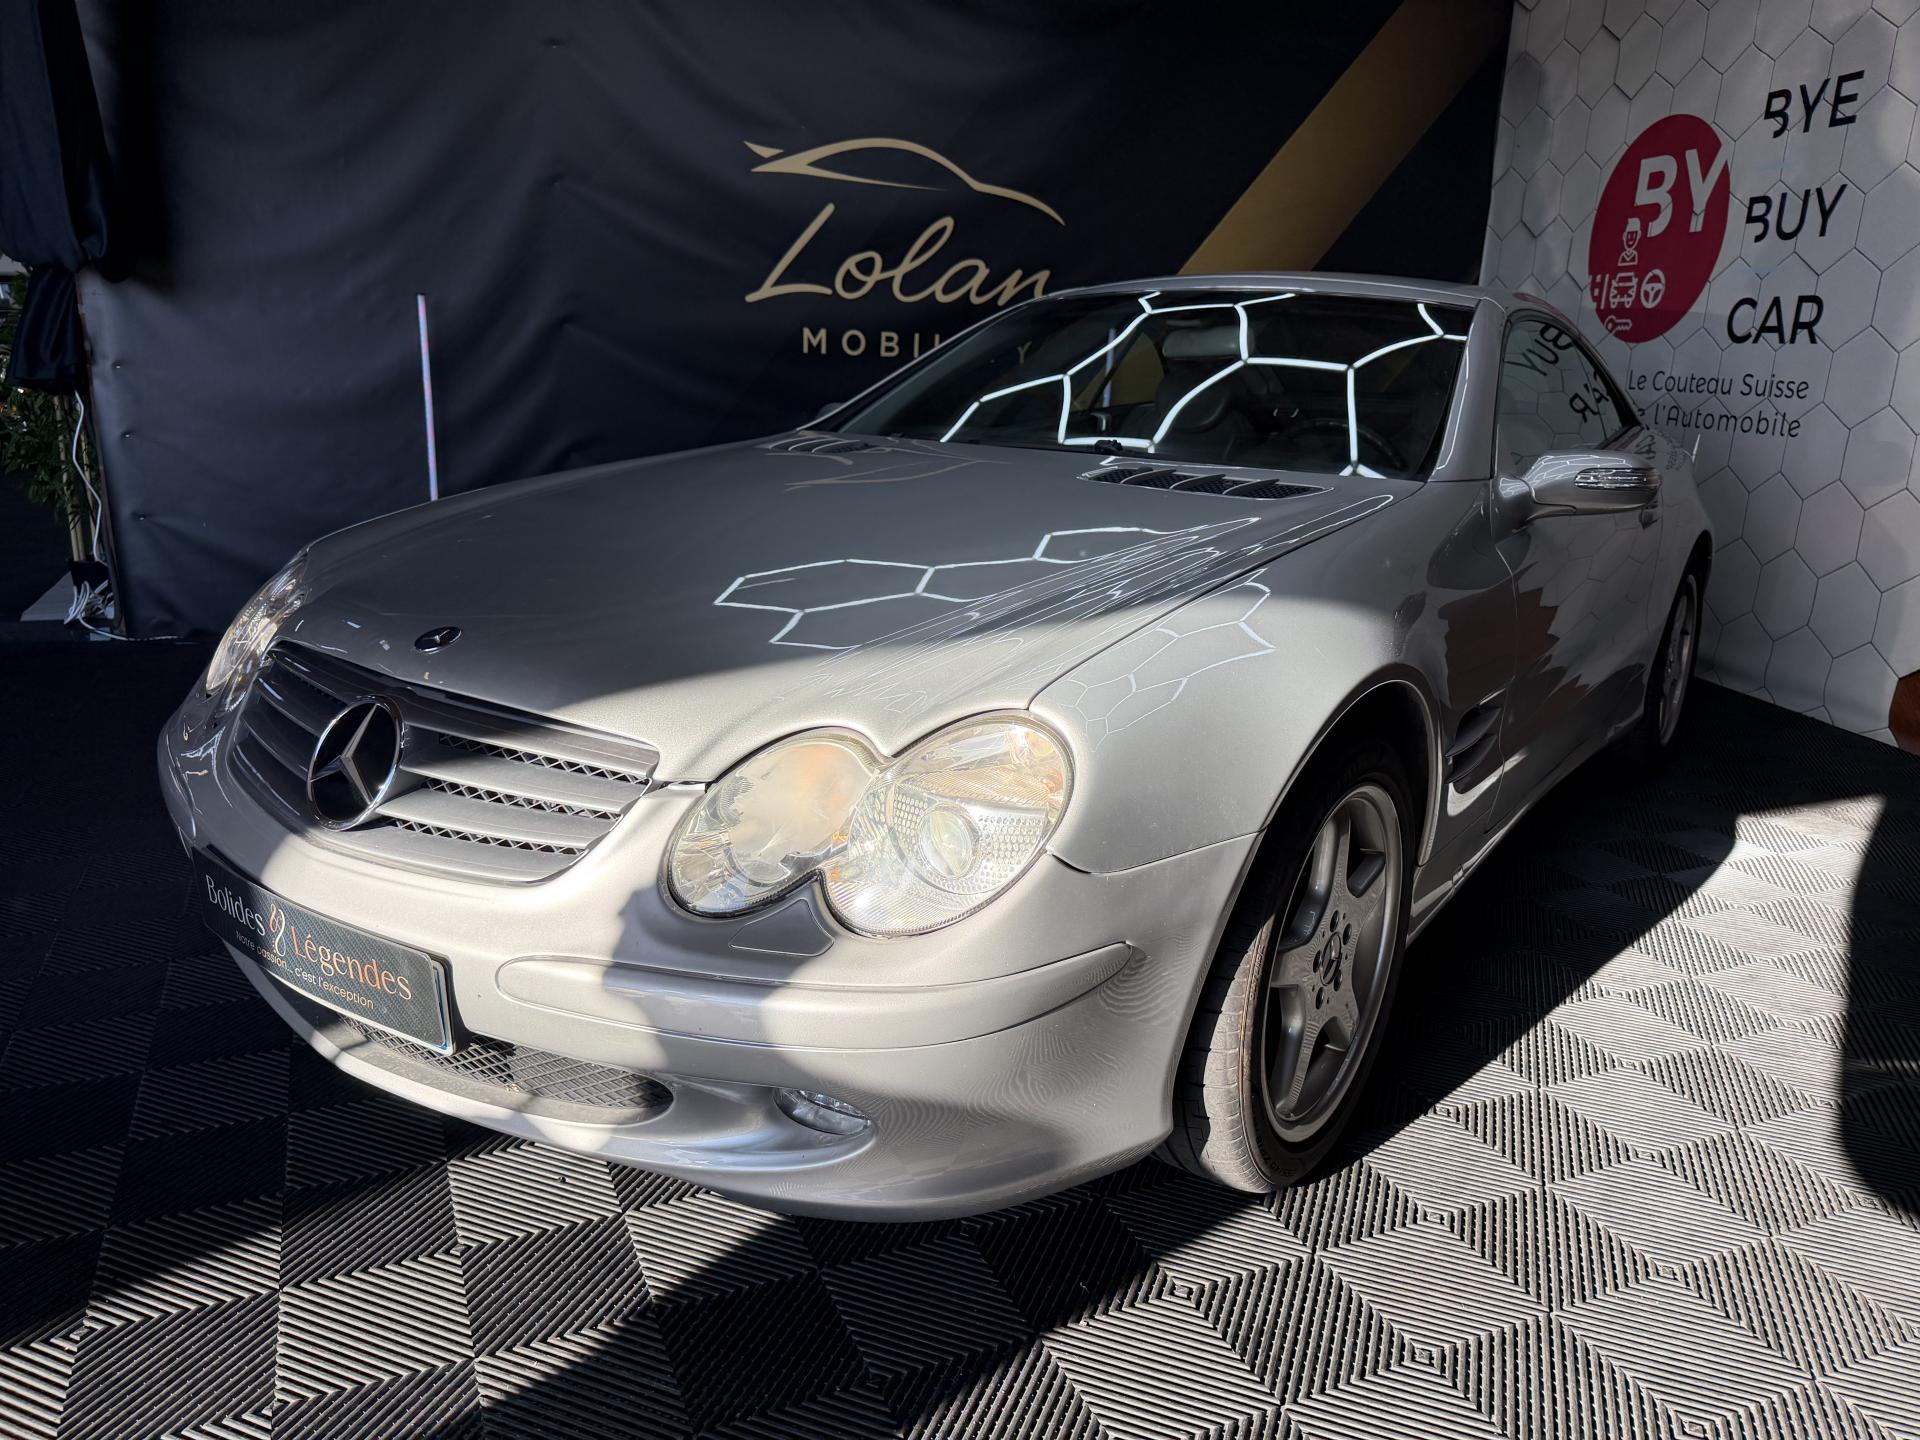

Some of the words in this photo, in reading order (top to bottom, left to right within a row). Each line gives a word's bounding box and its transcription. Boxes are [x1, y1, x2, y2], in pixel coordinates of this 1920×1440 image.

[1764, 70, 1865, 138] BYE
[1634, 145, 1729, 238] BY
[1745, 184, 1847, 243] BUY
[744, 202, 1051, 307] Lolan
[1726, 295, 1824, 345] CAR
[1629, 370, 1647, 390] Le
[1652, 371, 1733, 396] Couteau
[1740, 373, 1809, 399] Suisse
[1654, 404, 1801, 438] l'Automobile
[205, 874, 266, 936] Bolides
[291, 927, 412, 1000] Légendes
[294, 968, 316, 985] c'est
[318, 977, 374, 1009] l'exception
